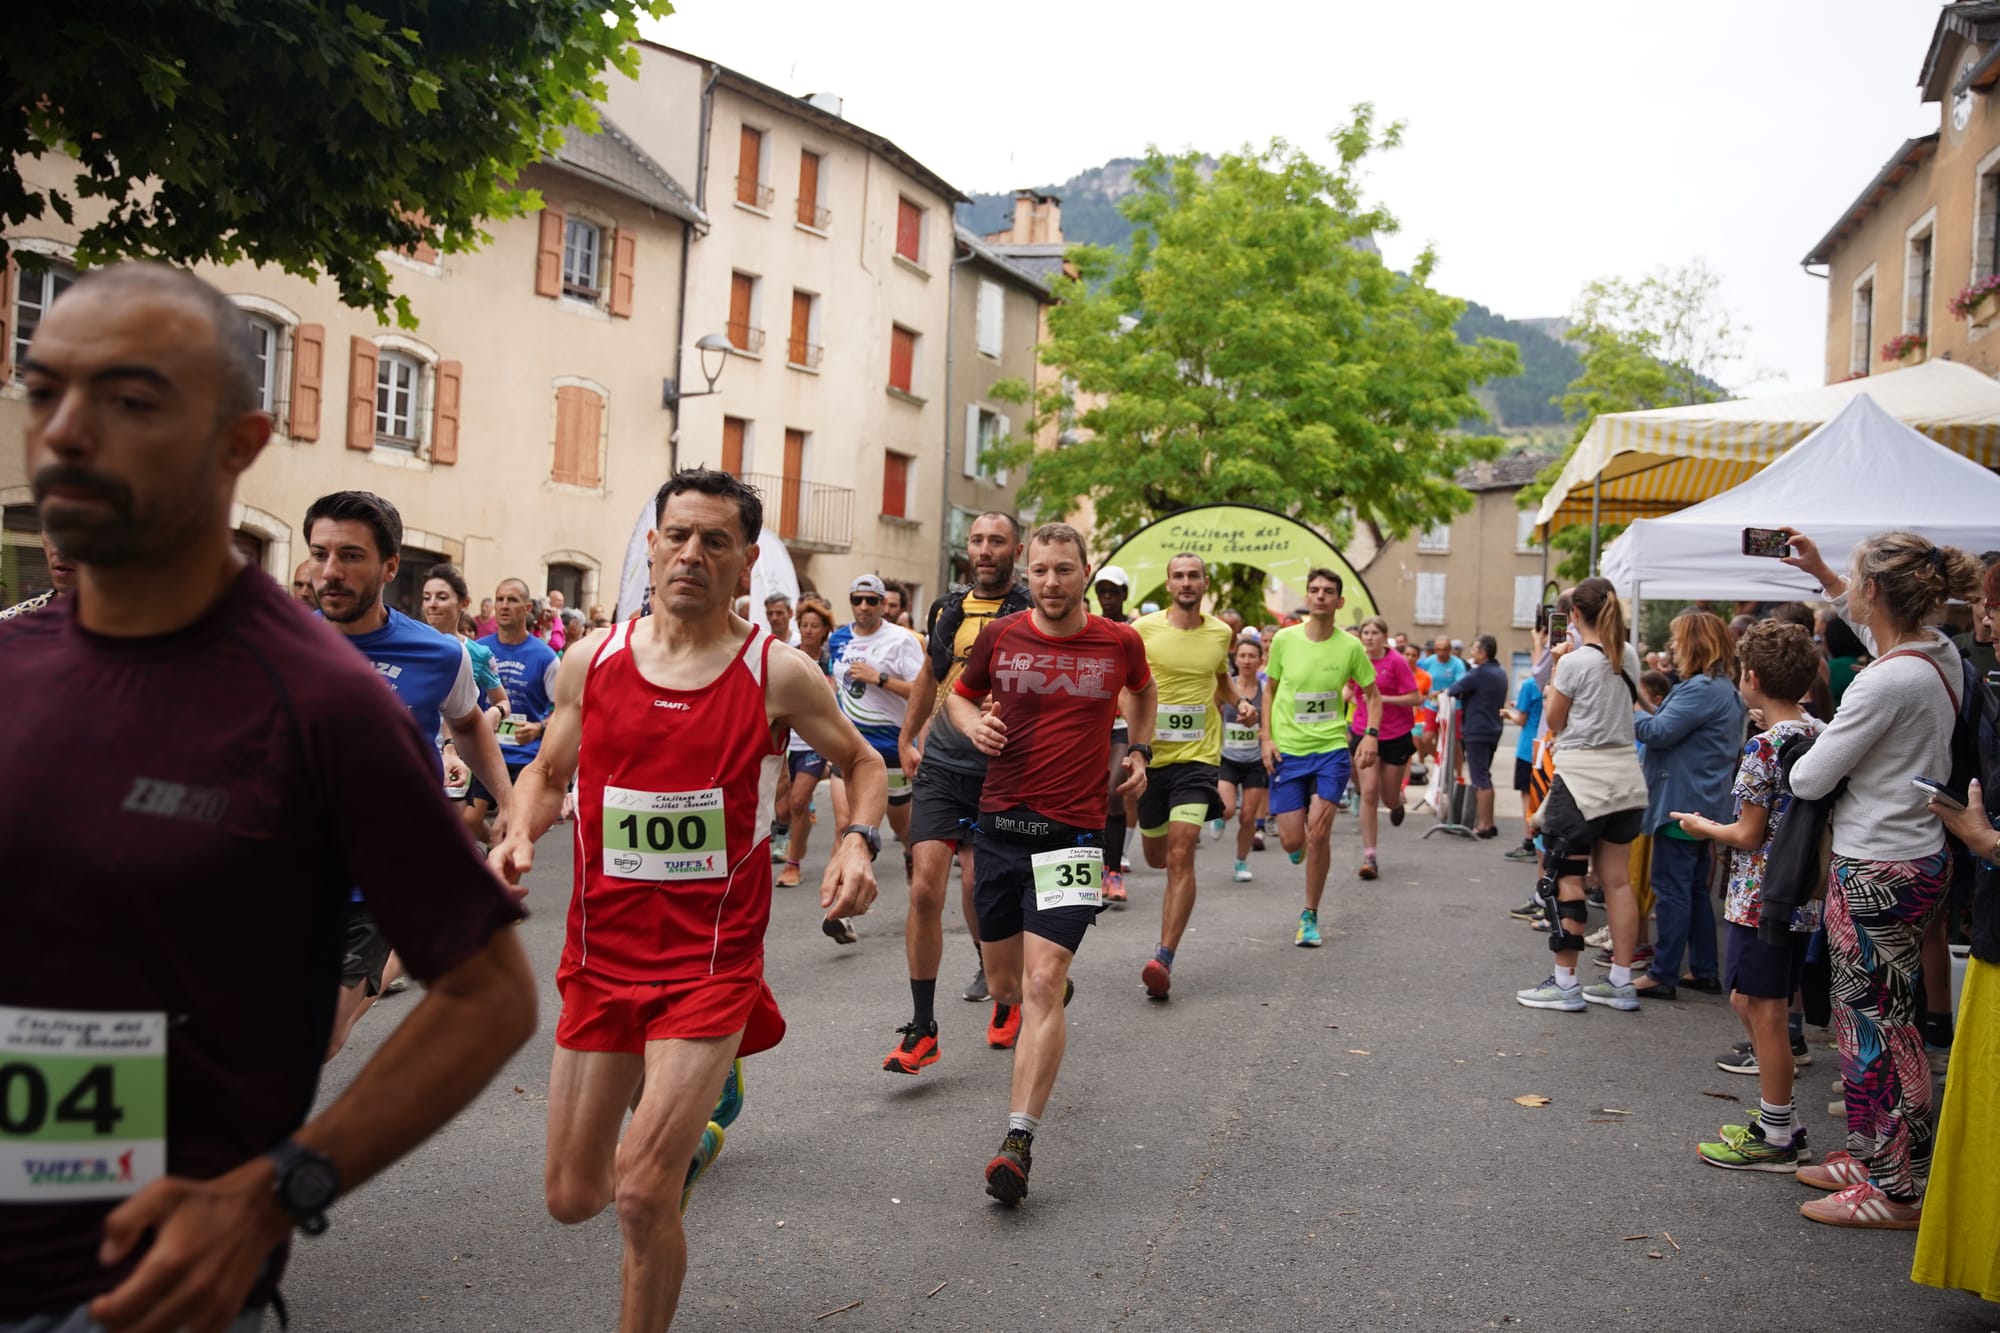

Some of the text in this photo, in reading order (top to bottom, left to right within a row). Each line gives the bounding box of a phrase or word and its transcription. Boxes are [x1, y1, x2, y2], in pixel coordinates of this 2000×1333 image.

[1170, 526, 1280, 543] Challenge des
[996, 669, 1113, 699] TRAIL
[1306, 700, 1326, 713] 21
[1169, 714, 1193, 730] 99
[1230, 730, 1255, 741] 120
[619, 814, 707, 851] 100
[1055, 863, 1092, 887] 35
[0, 1060, 125, 1137] 04
